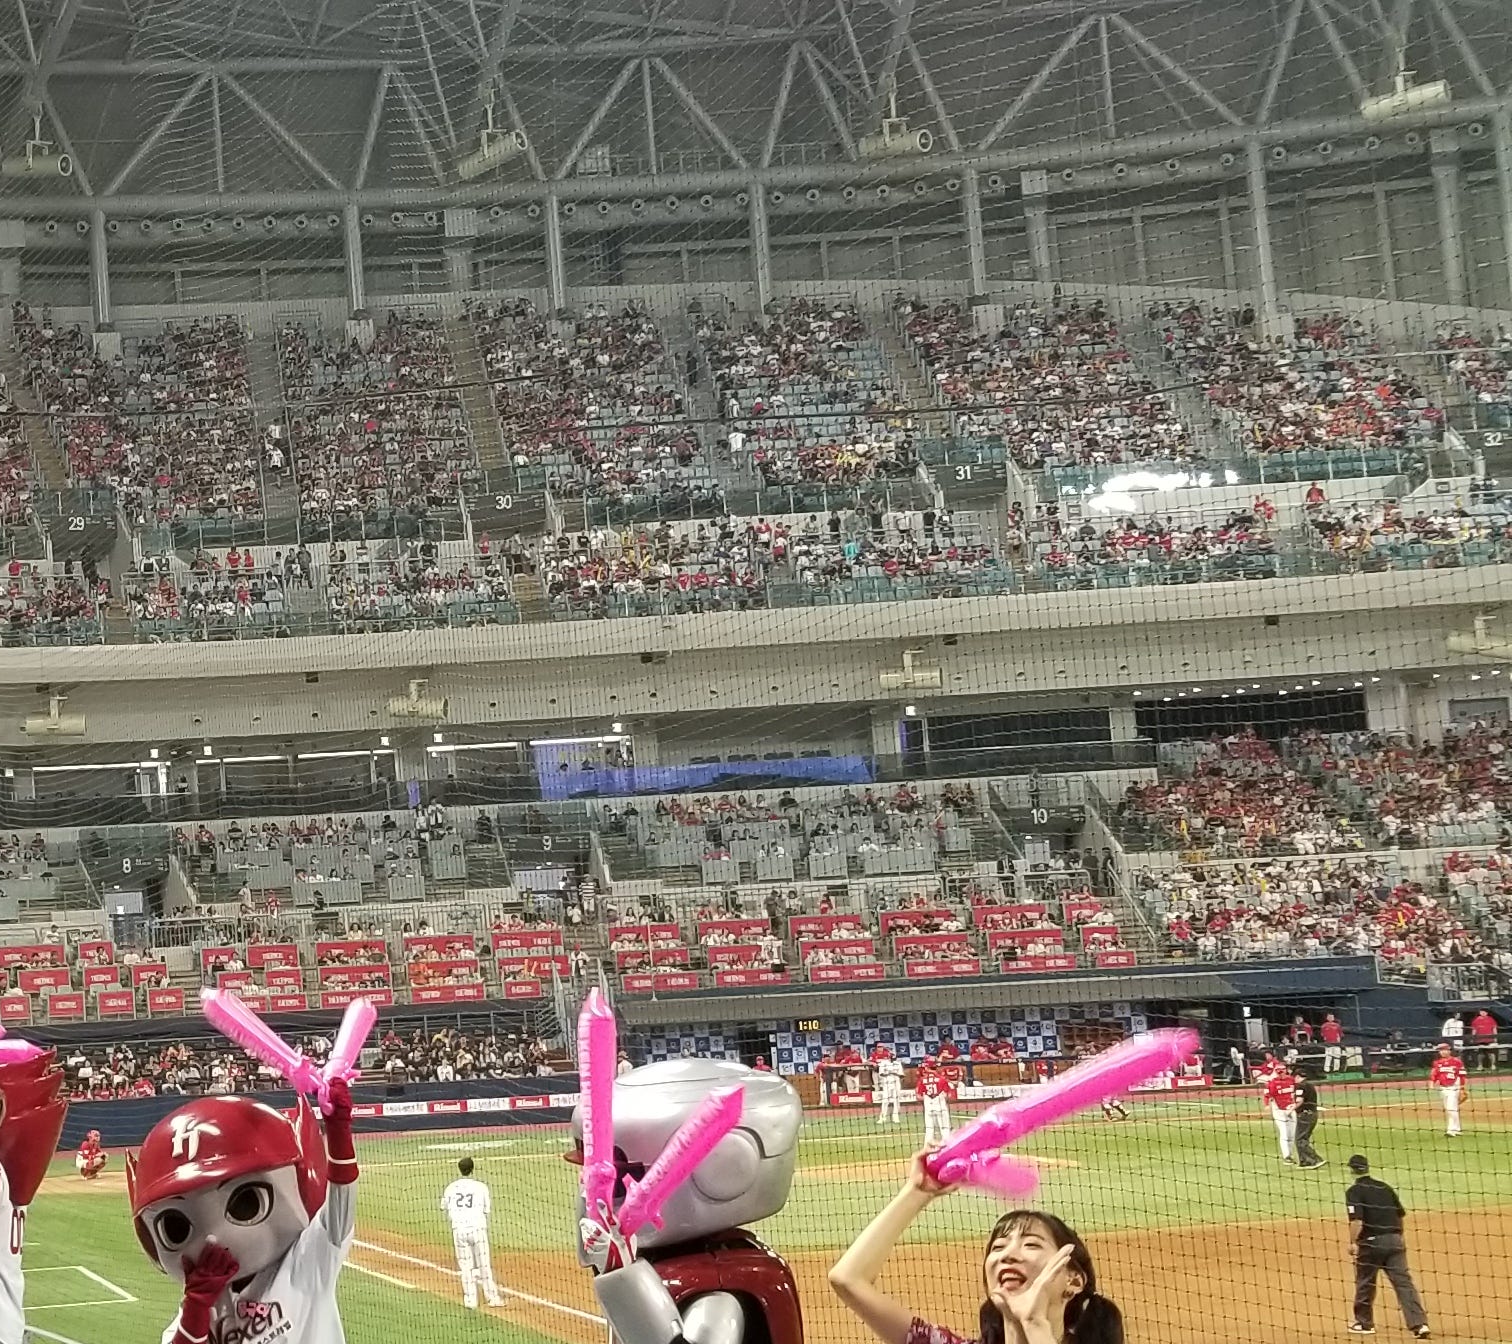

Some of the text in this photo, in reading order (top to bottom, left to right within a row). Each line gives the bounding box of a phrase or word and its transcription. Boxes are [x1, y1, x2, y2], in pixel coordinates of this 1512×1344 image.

[955, 465, 972, 480] 31
[496, 495, 512, 510] 30
[68, 517, 85, 531] 29
[1030, 808, 1048, 825] 10
[542, 836, 552, 851] 9
[122, 857, 132, 874] 8
[799, 1020, 819, 1031] 1:10
[455, 1192, 474, 1209] 23
